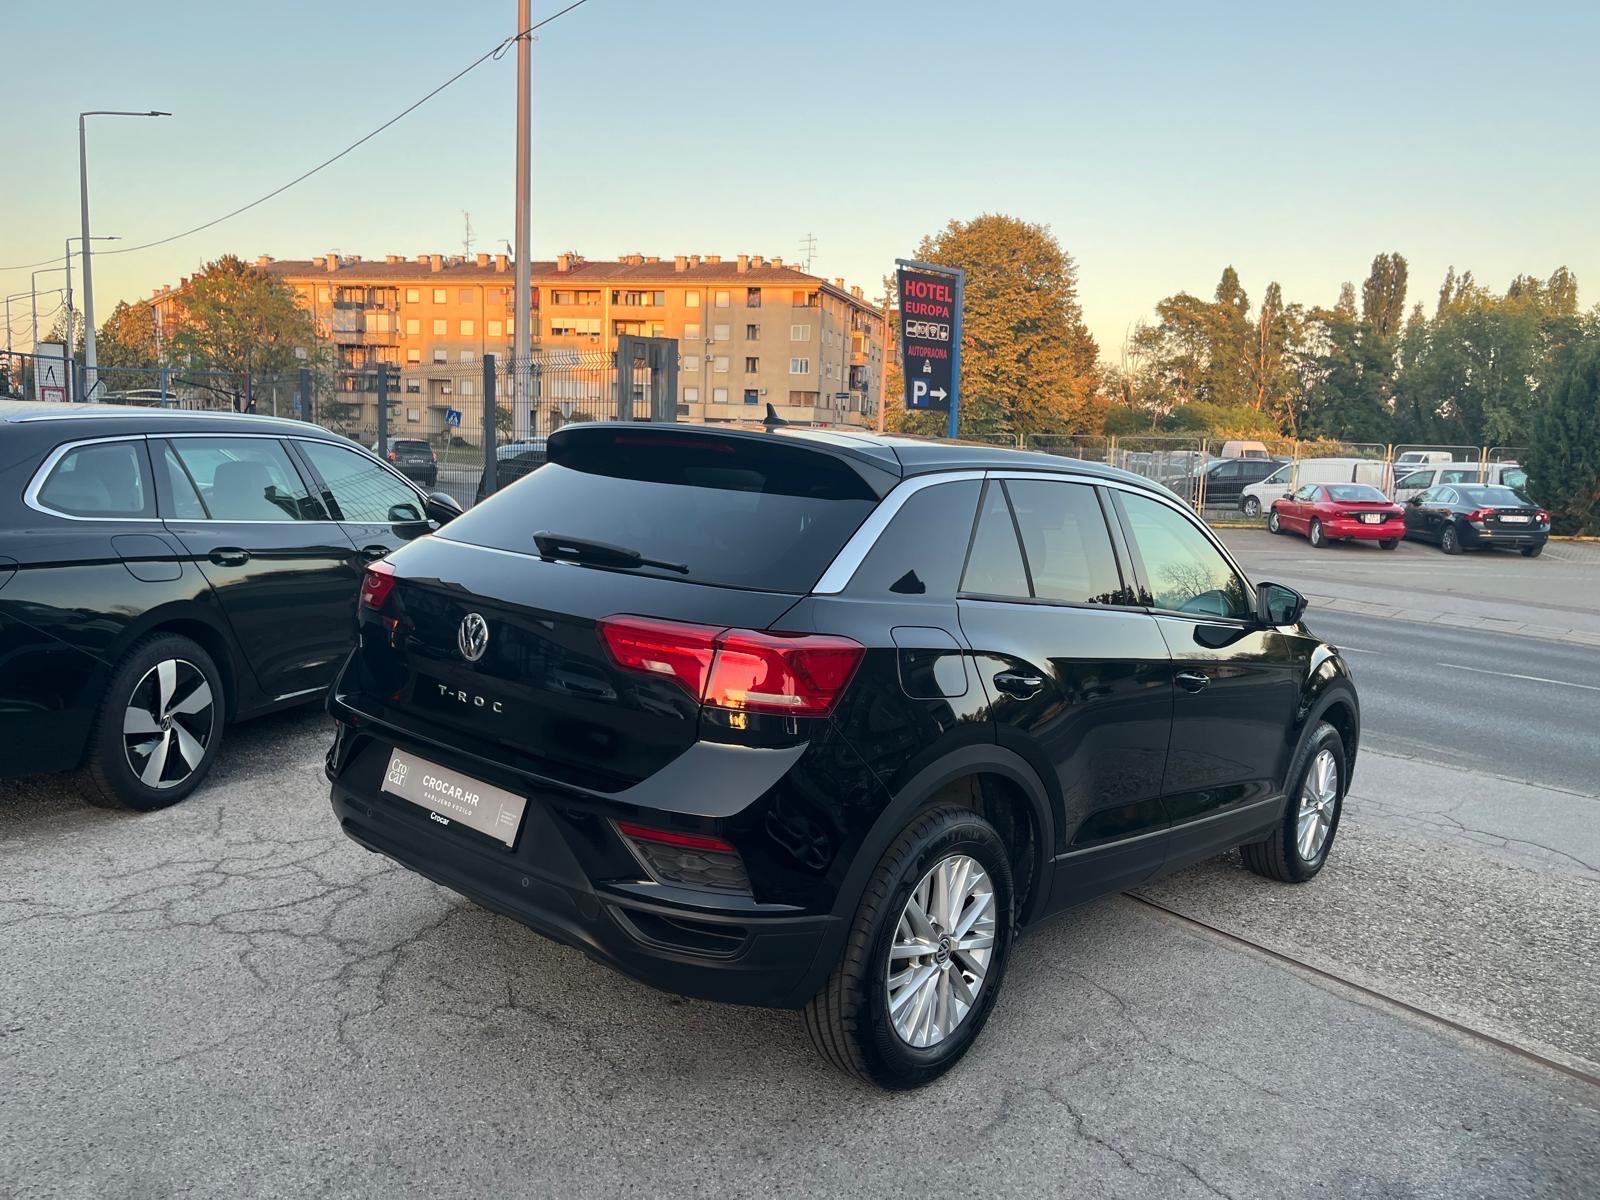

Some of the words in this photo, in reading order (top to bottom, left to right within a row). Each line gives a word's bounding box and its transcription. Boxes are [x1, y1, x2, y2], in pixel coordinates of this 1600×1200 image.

[905, 279, 952, 303] HOTEL
[905, 301, 950, 318] EUROPA
[912, 380, 928, 405] P
[438, 684, 503, 713] T-ROC
[422, 775, 480, 807] CROCAR.HR
[430, 811, 450, 826] Crocar
